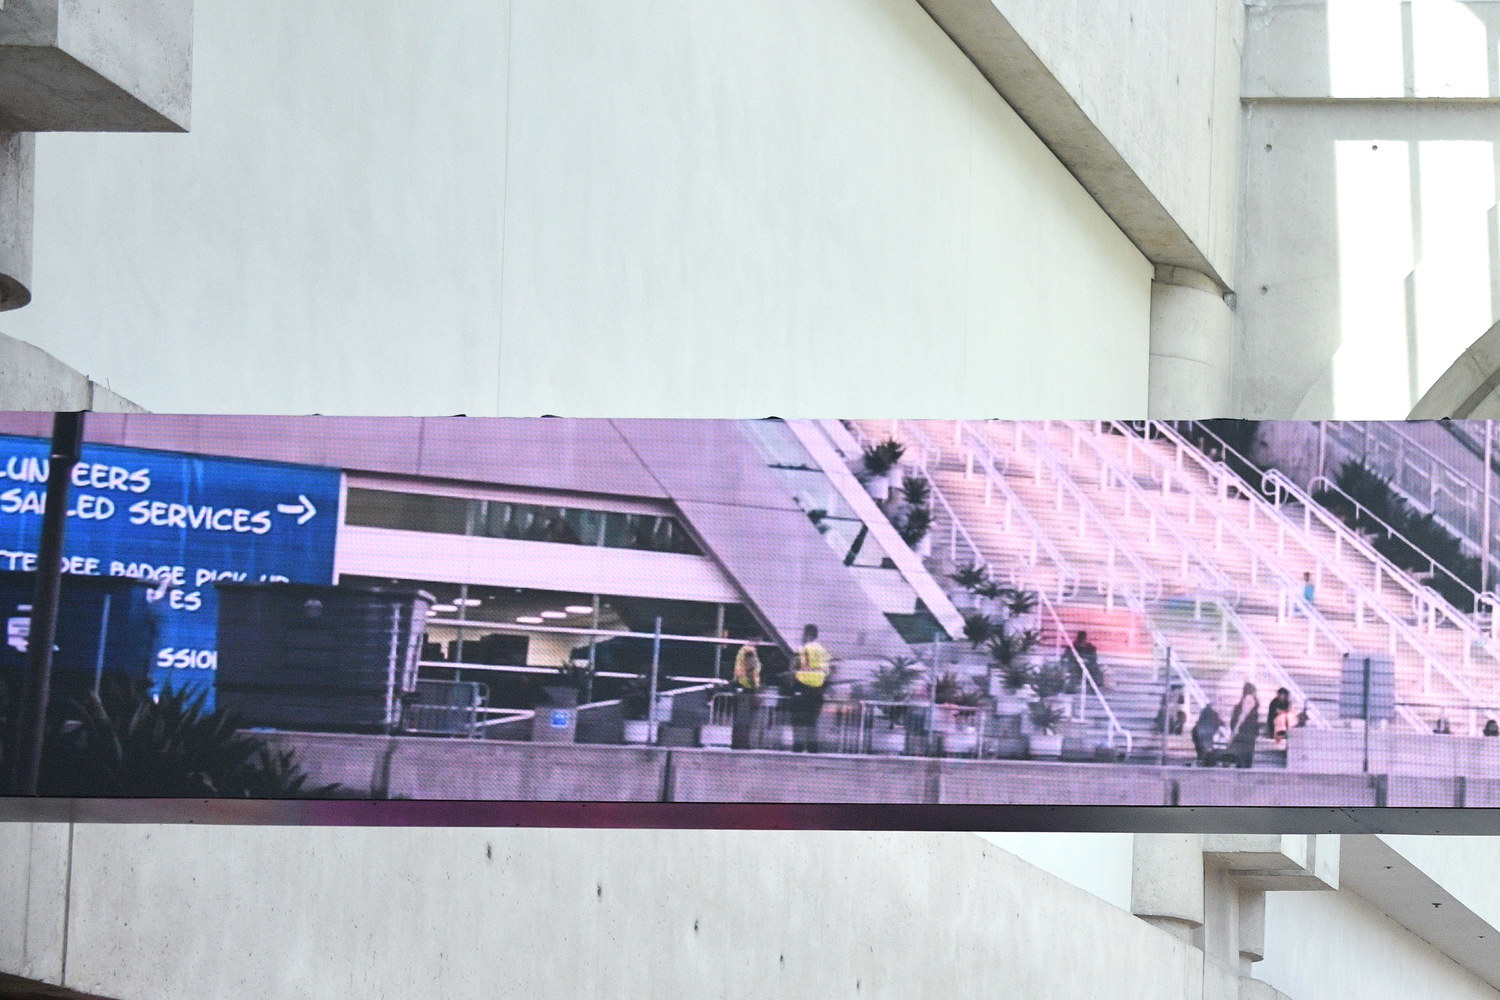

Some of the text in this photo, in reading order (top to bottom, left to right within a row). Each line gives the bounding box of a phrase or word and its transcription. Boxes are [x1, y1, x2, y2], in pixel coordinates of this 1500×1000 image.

[0, 456, 151, 493] UNEERS
[0, 488, 271, 534] SAED SERVICES
[110, 560, 186, 585] BADGE
[156, 647, 217, 670] SSIO
